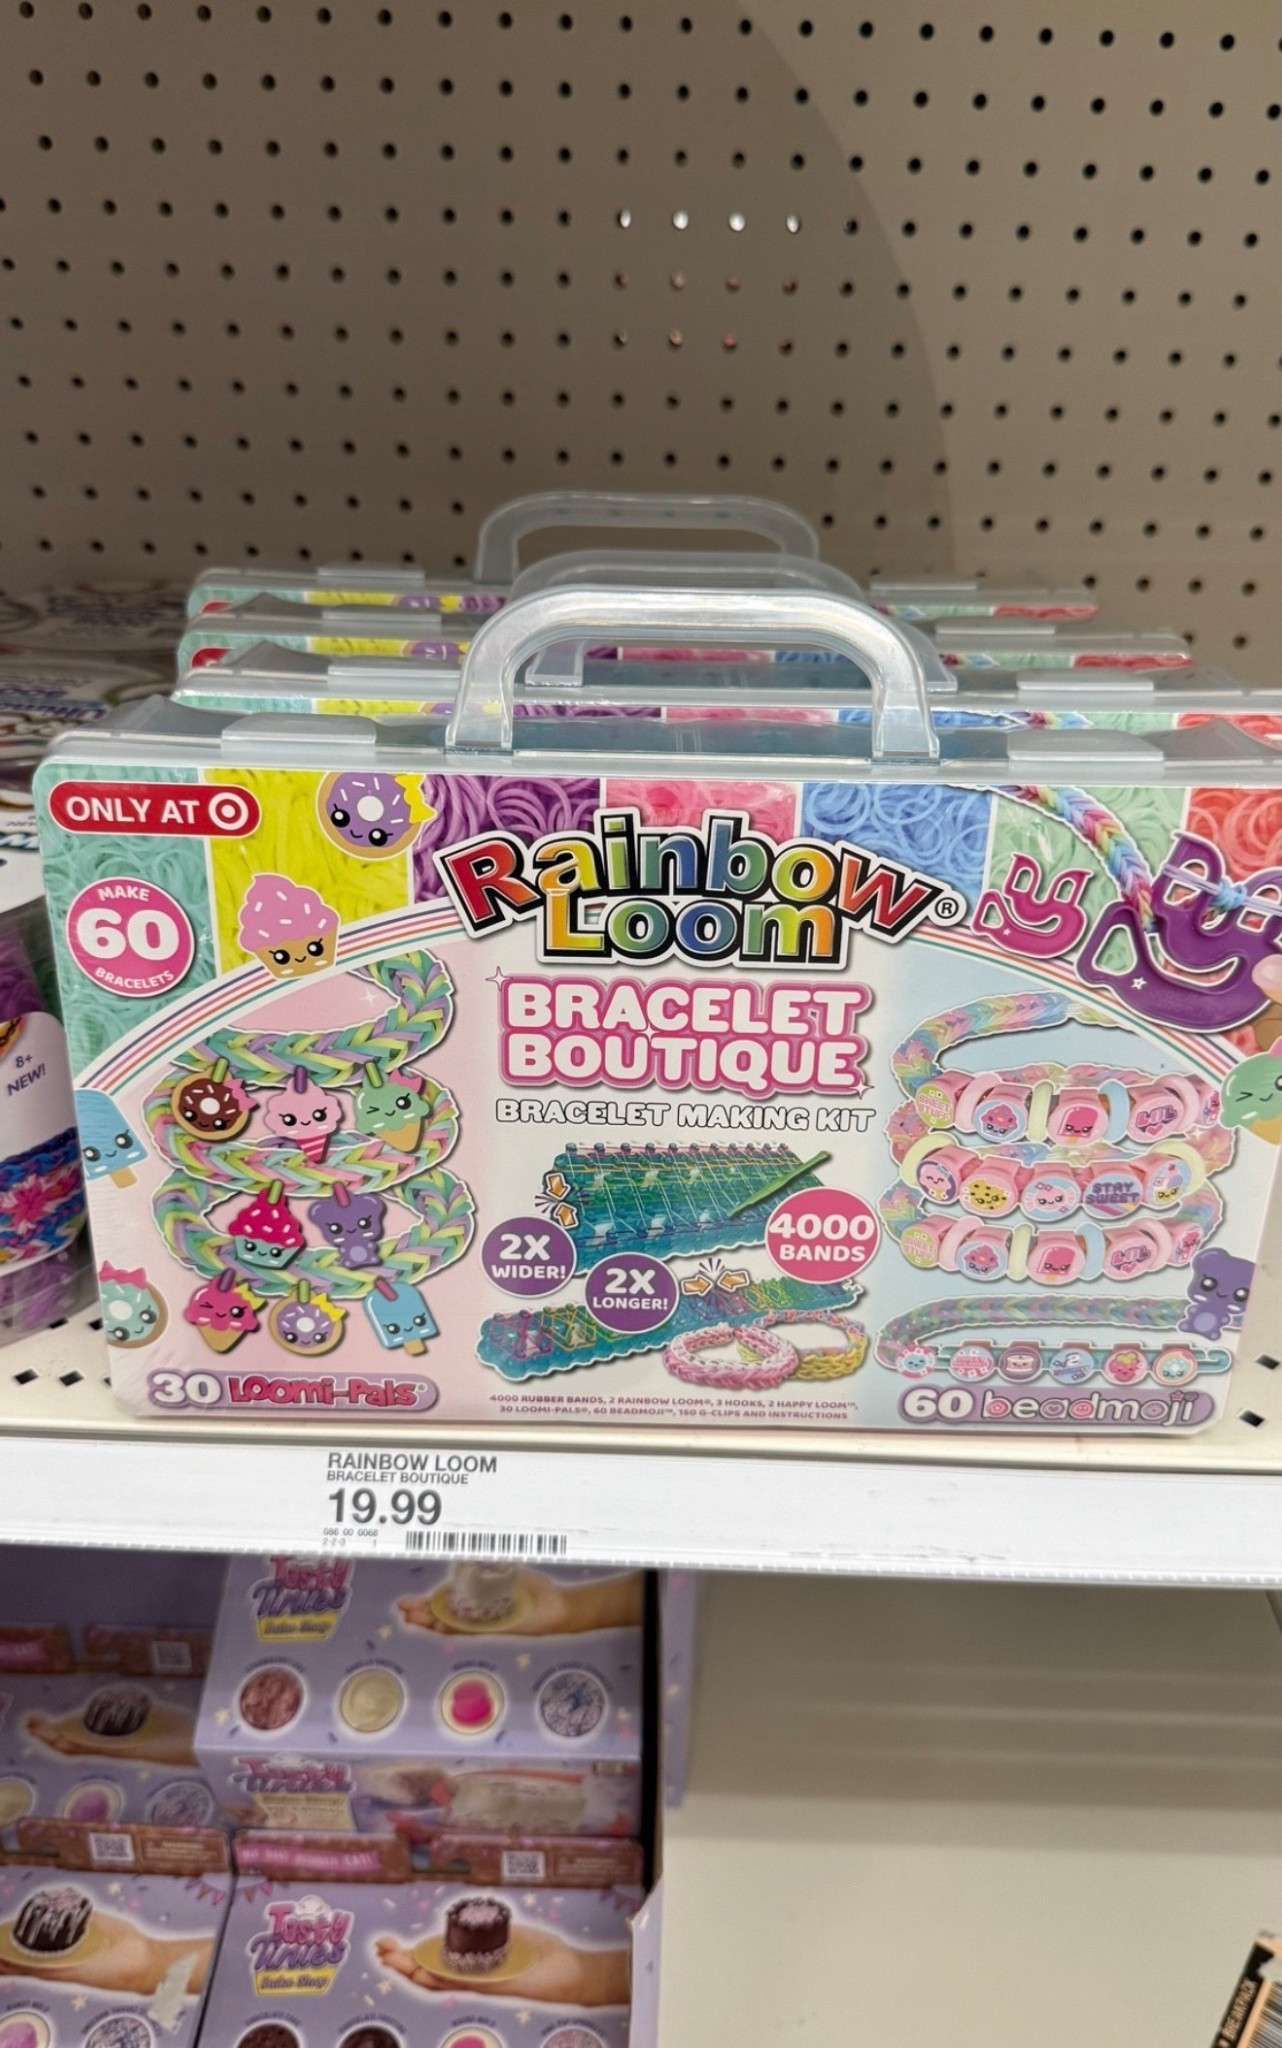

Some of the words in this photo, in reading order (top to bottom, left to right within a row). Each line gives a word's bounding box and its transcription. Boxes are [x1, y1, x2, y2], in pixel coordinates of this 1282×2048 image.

[67, 796, 150, 824] ONLY
[161, 799, 200, 825] AT
[97, 885, 151, 903] MAKE
[76, 907, 180, 962] 60
[543, 892, 845, 962] Loom
[94, 967, 175, 990] BRACELETS
[508, 982, 862, 1036] BRACELET
[14, 1054, 33, 1069] 8+
[507, 1033, 858, 1090] BOUTIQUE
[7, 1062, 46, 1097] NEW!
[495, 1098, 671, 1127] BRACELET
[676, 1103, 810, 1131] MAKING
[815, 1107, 877, 1133] KIT
[1085, 1192, 1140, 1205] SWEET
[1091, 1182, 1134, 1194] STAY
[768, 1213, 874, 1242] 4000
[500, 1233, 551, 1261] 2X
[779, 1244, 866, 1263] BANDS
[491, 1264, 566, 1280] WIDER!
[604, 1267, 656, 1294] 2X
[592, 1296, 668, 1311] LONGER!
[152, 1373, 222, 1405] 30
[490, 1394, 519, 1402] 4000
[521, 1395, 565, 1403] RUBBER
[567, 1396, 607, 1405] BANDS,
[618, 1397, 670, 1405] RAINBOW
[725, 1399, 766, 1408] HOOKS,
[768, 1400, 775, 1408] 2
[777, 1401, 813, 1409] HAPPY
[500, 1405, 513, 1413] 30
[593, 1407, 607, 1415] 60
[743, 1410, 767, 1418] AND
[769, 1411, 849, 1419] INSTRUCTIONS
[902, 1387, 974, 1420] 60
[980, 1391, 1200, 1427] beadmoji
[327, 1452, 429, 1471] RAINBOW
[435, 1454, 498, 1473] LOOM
[326, 1471, 396, 1483] BRACELET
[400, 1472, 469, 1485] BOUTIQUE
[328, 1487, 443, 1526] 19.99
[343, 1529, 354, 1537] 00
